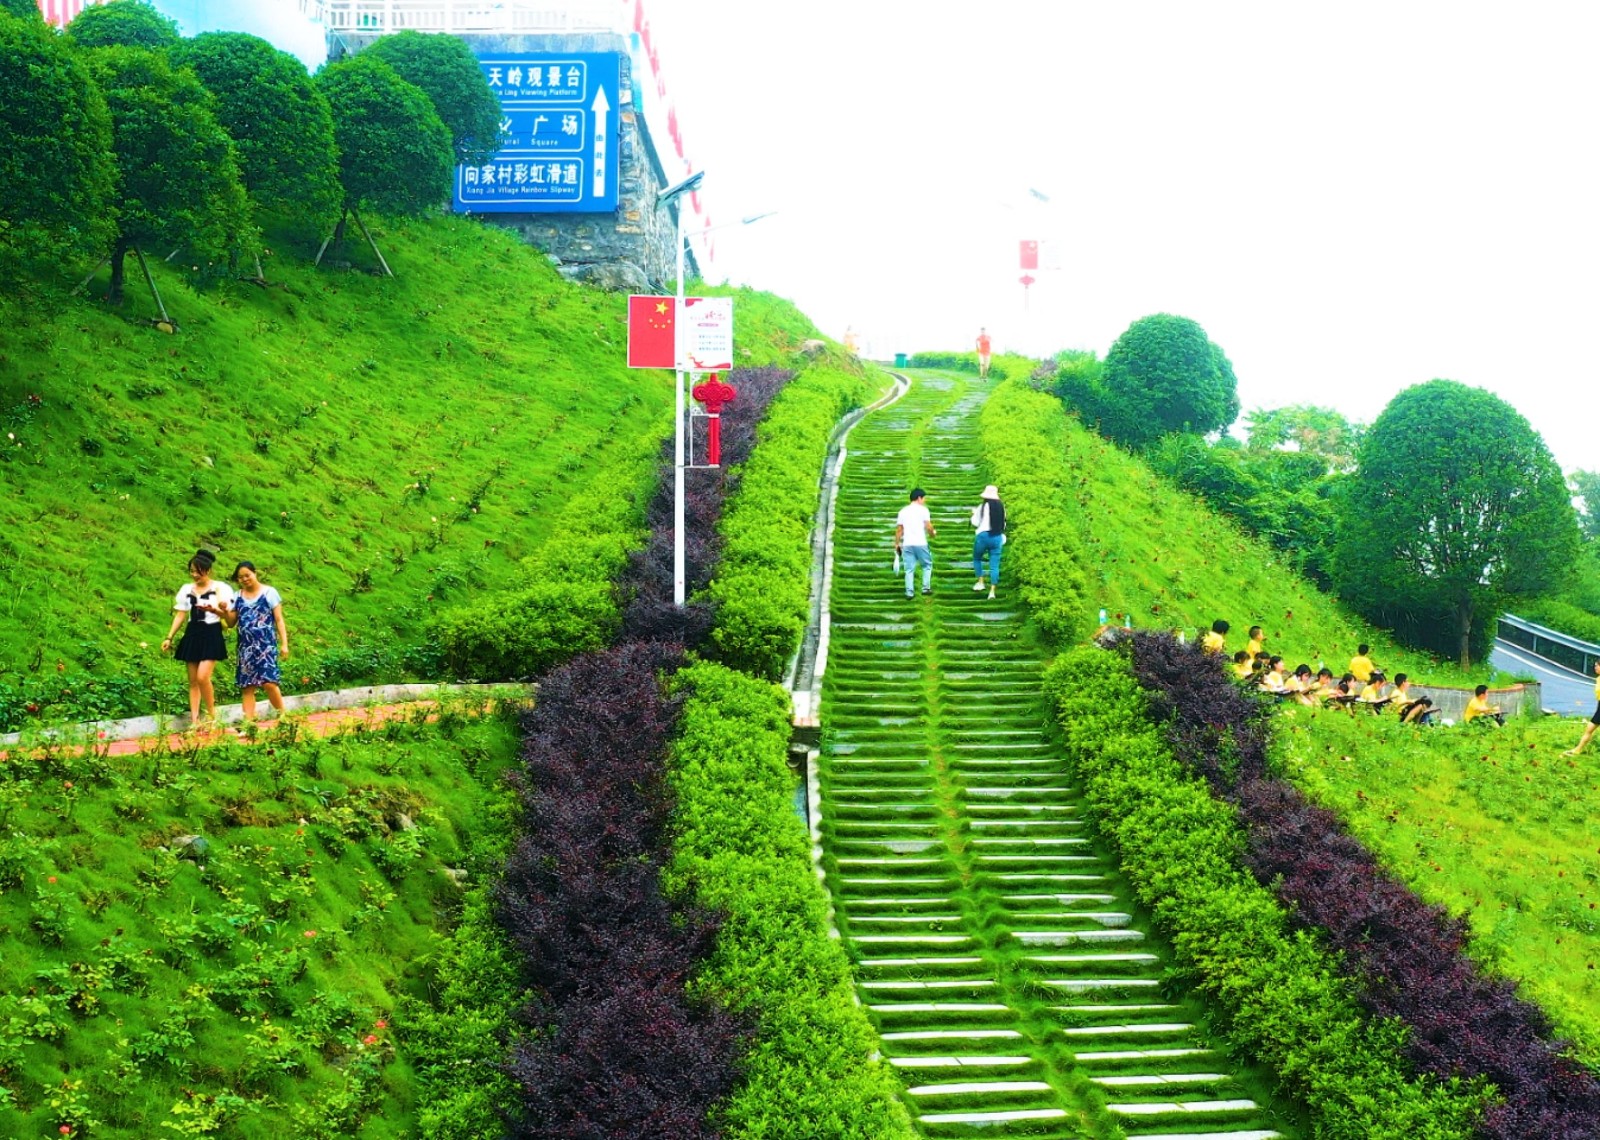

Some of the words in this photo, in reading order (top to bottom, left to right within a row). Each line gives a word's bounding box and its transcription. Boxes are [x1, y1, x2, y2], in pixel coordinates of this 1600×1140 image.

[488, 66, 581, 87] 天岭观景台
[520, 89, 547, 97] Viewing
[549, 88, 577, 96] Platform
[531, 138, 558, 147] Square
[465, 163, 578, 185] 向家村彩虹滑道
[498, 186, 519, 195] Village
[520, 186, 547, 194] Rainbow
[550, 186, 575, 194] Slipway
